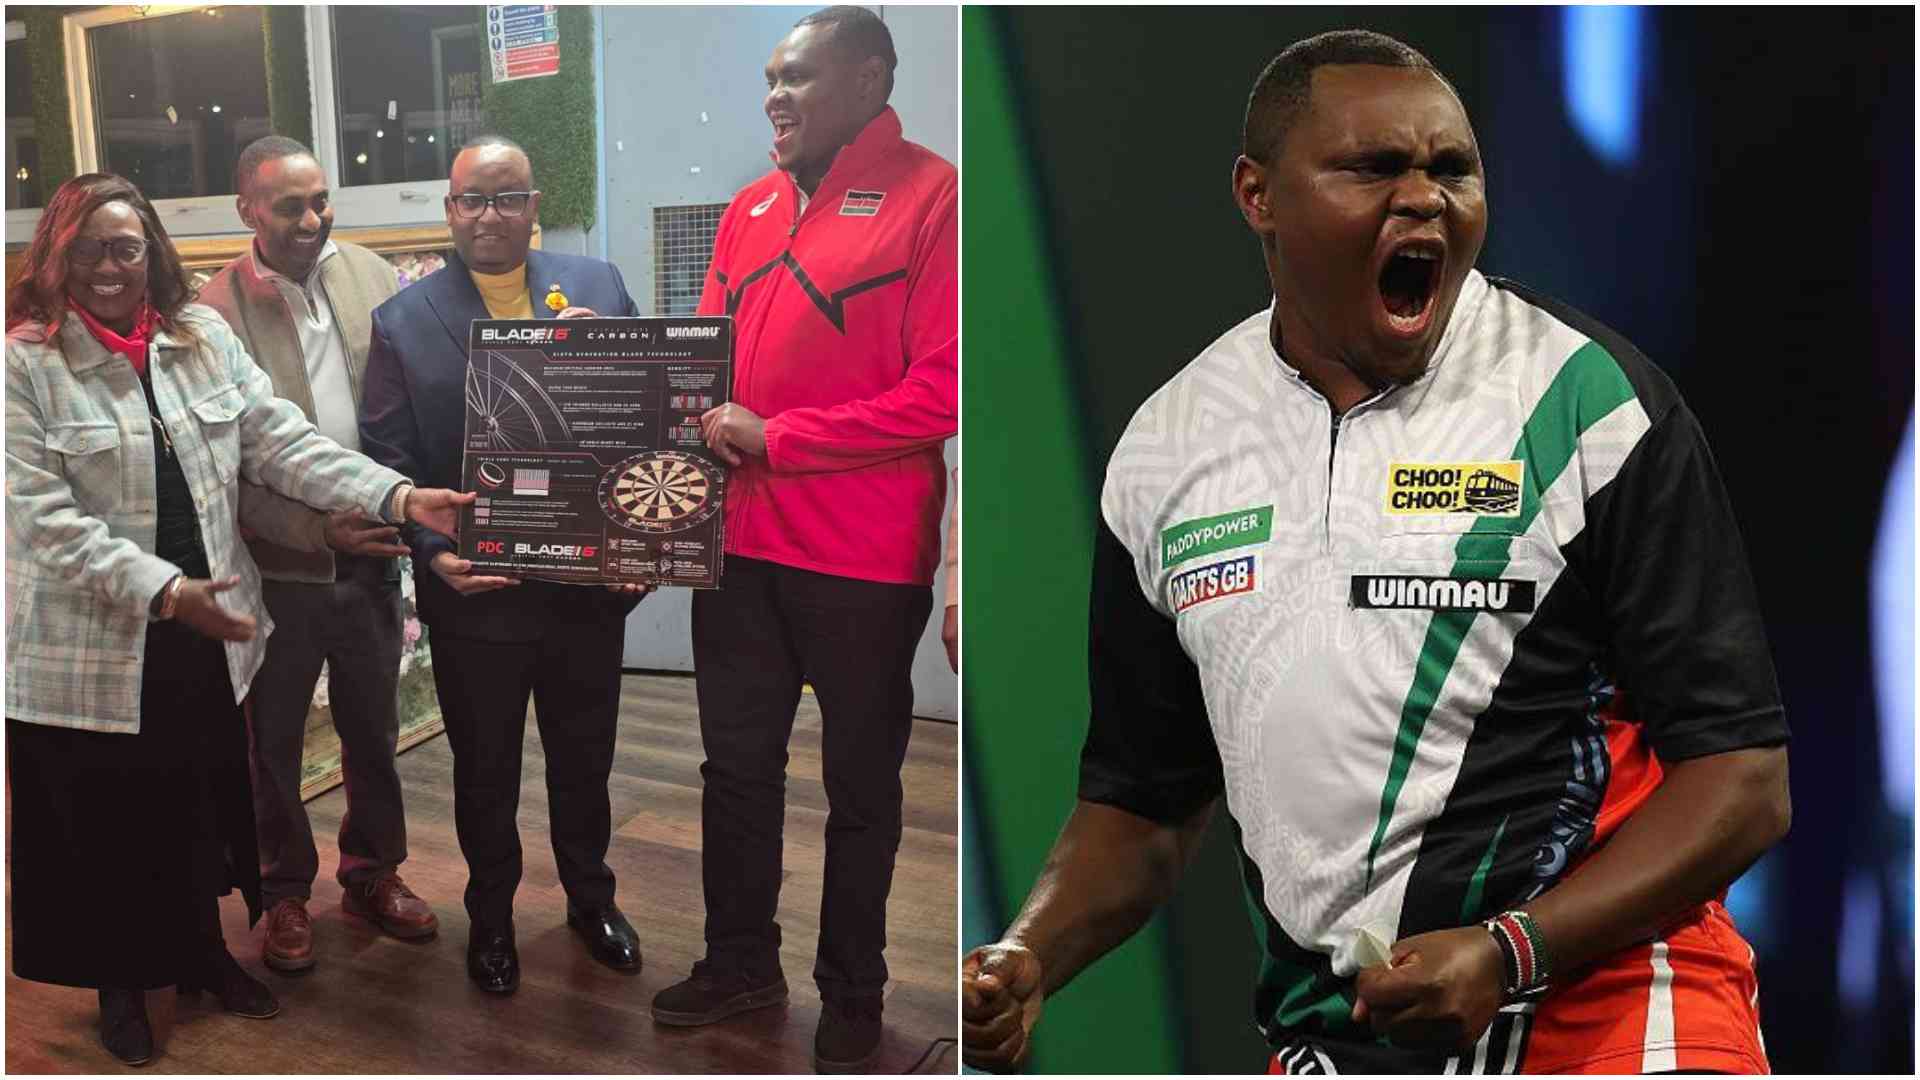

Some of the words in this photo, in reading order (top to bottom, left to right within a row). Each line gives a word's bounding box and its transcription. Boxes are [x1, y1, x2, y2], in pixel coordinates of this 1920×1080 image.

[586, 332, 649, 340] CARBON
[665, 326, 720, 338] WINMAU
[1394, 469, 1462, 487] CHOO!
[1392, 491, 1459, 509] CHOO!
[477, 541, 505, 554] PDC
[1221, 560, 1249, 592] GB
[1367, 578, 1510, 610] WINMAU
